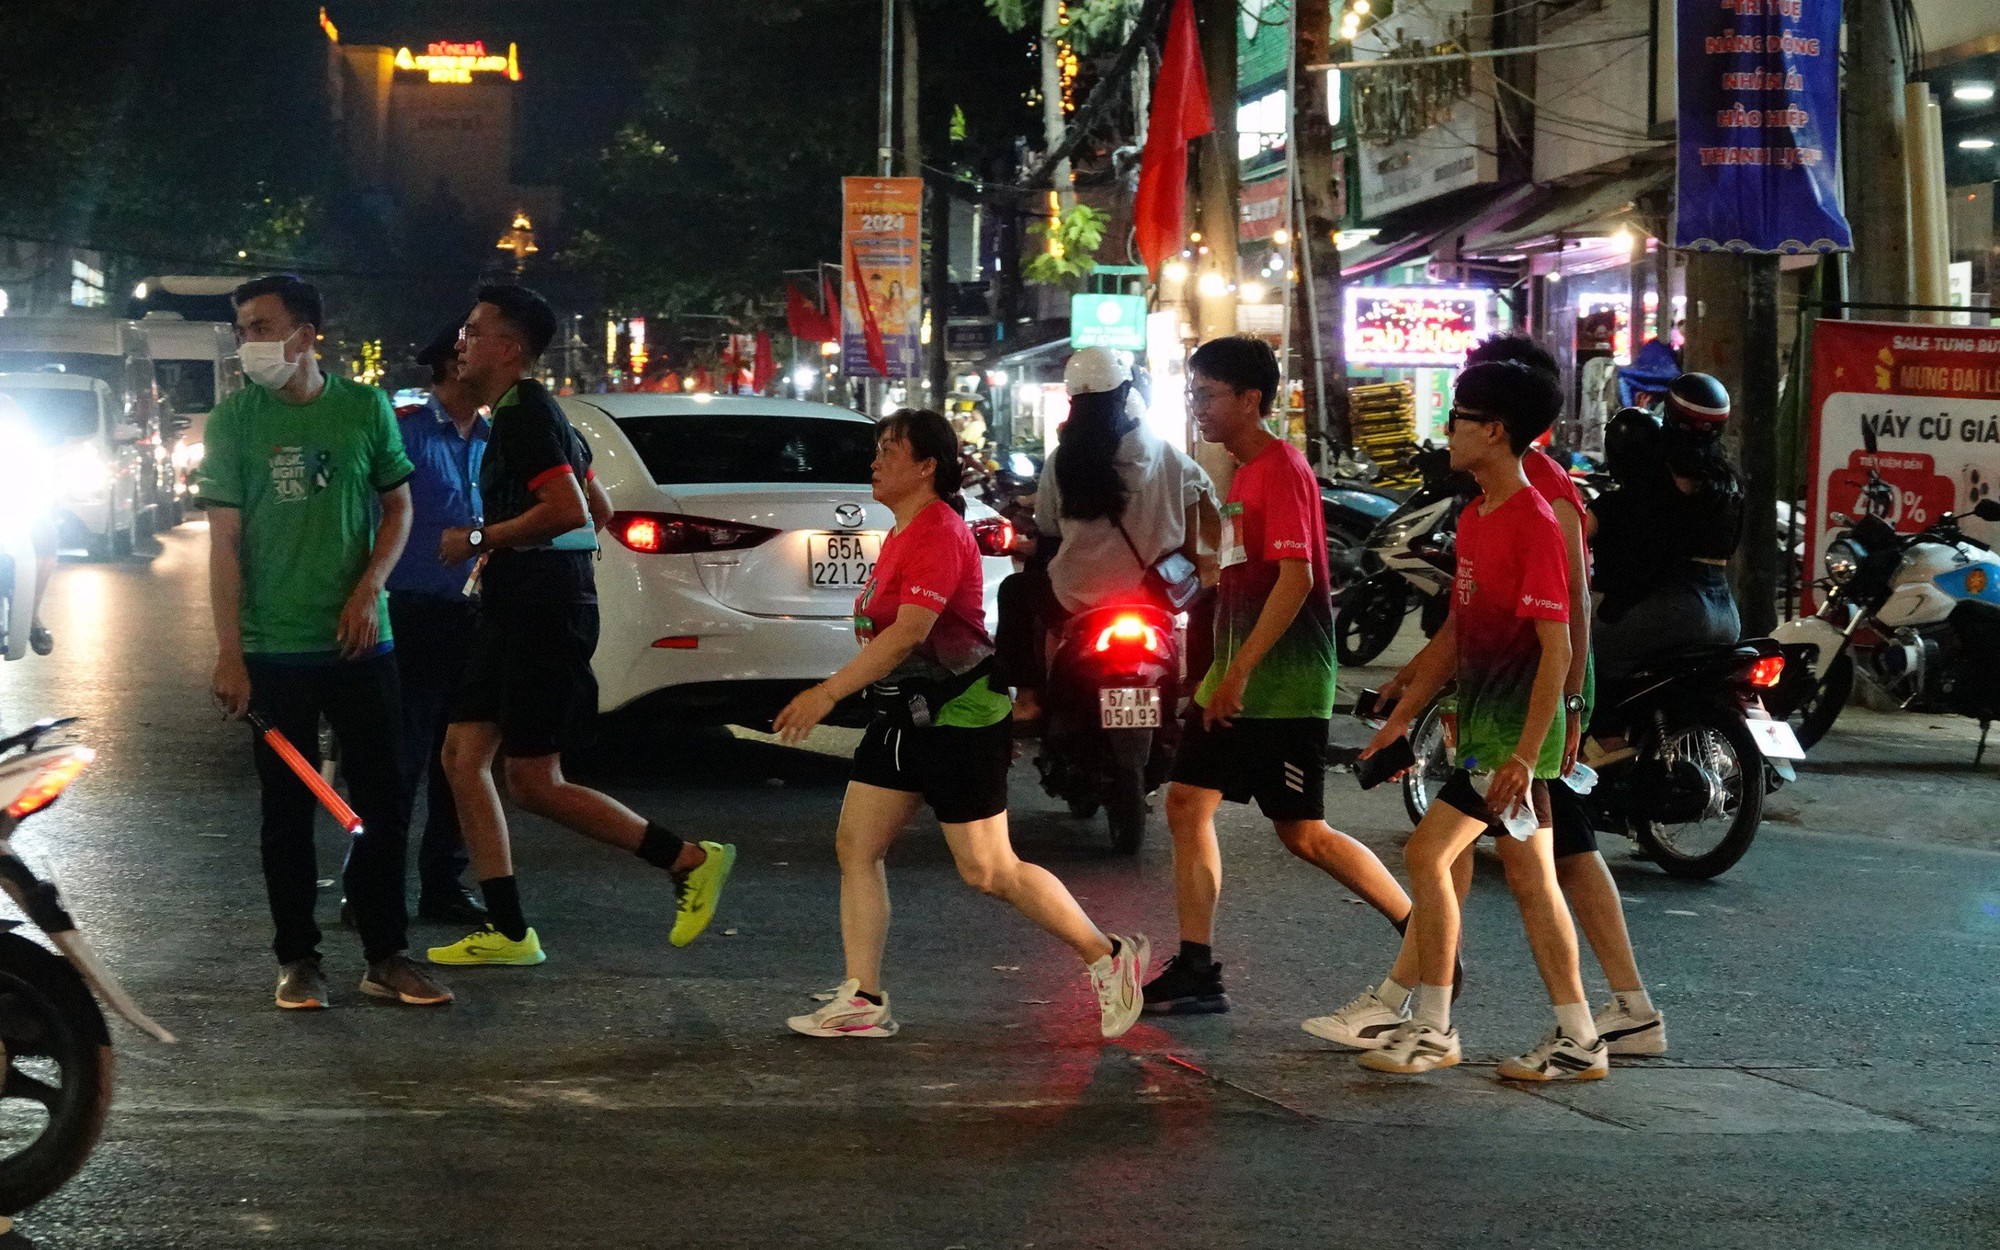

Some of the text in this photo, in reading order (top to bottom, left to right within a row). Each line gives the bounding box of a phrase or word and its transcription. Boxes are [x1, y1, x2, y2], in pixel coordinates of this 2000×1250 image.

[1705, 28, 1820, 58] NĂNG ĐỘNG
[1722, 66, 1782, 90] NHÂN
[1699, 147, 1771, 166] THANH
[861, 213, 905, 232] 2024
[1892, 335, 1930, 351] SALE
[1919, 412, 1953, 441] CŨ
[828, 537, 864, 560] 65A
[922, 588, 947, 605] VPBan
[1534, 598, 1564, 611] VPBank
[1104, 708, 1158, 727] 050.93
